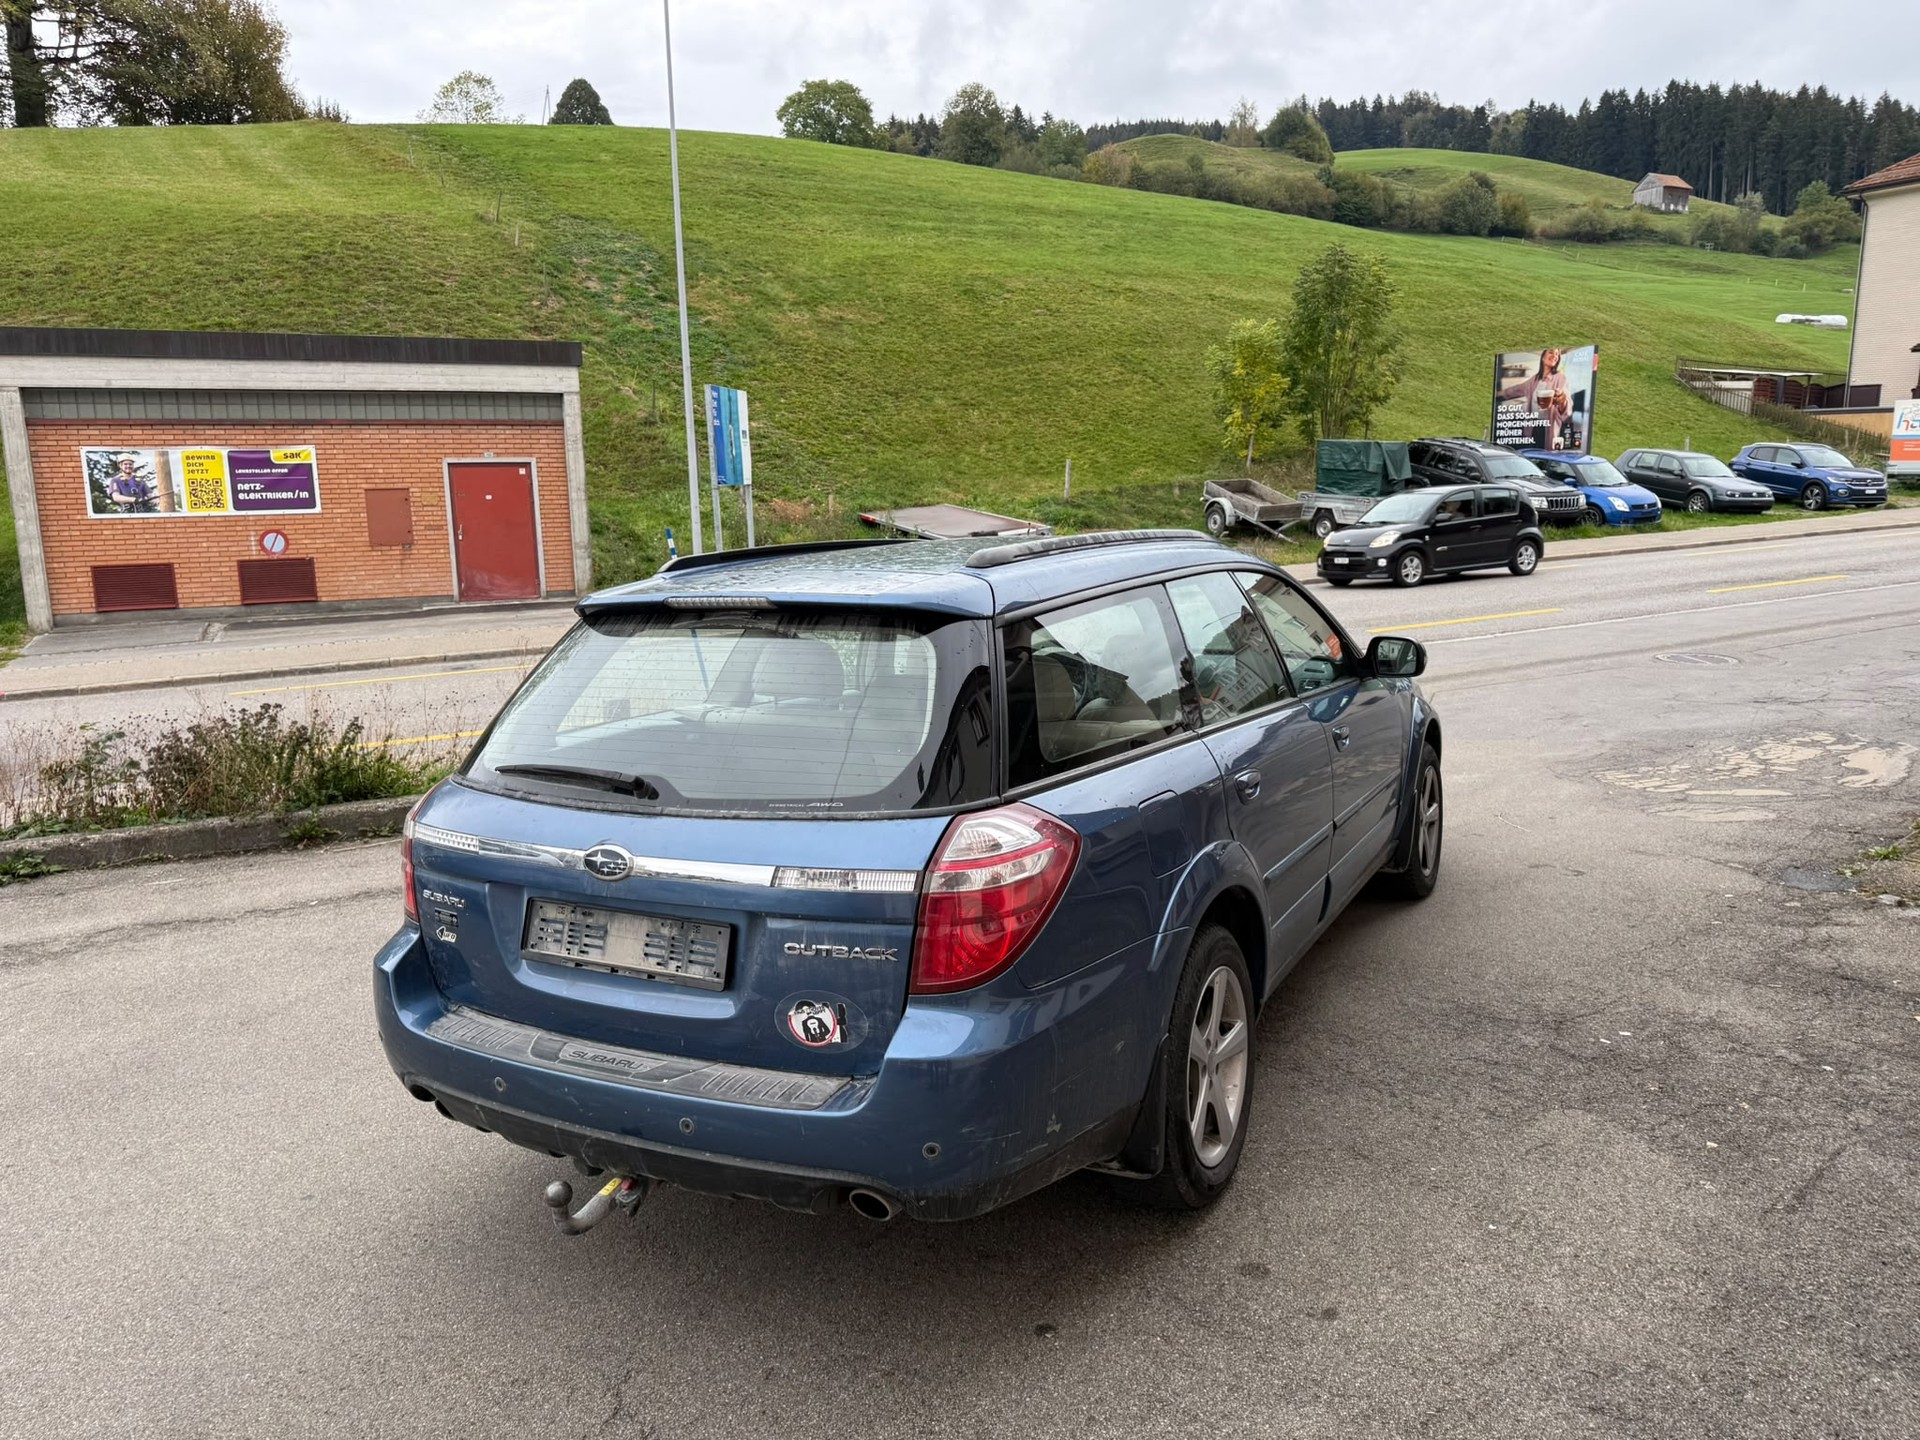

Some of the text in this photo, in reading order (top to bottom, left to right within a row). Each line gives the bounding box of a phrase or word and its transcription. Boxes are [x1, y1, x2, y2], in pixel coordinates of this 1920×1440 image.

[1497, 411, 1539, 420] DASS SOGAR
[1496, 419, 1551, 428] MORGENMUFFEL
[1496, 428, 1523, 437] FRÜHER
[1496, 436, 1536, 445] AUFSTEHEN.
[422, 889, 465, 908] SUBARU
[783, 942, 899, 961] OUTBACK
[568, 1050, 644, 1070] SUBARU
